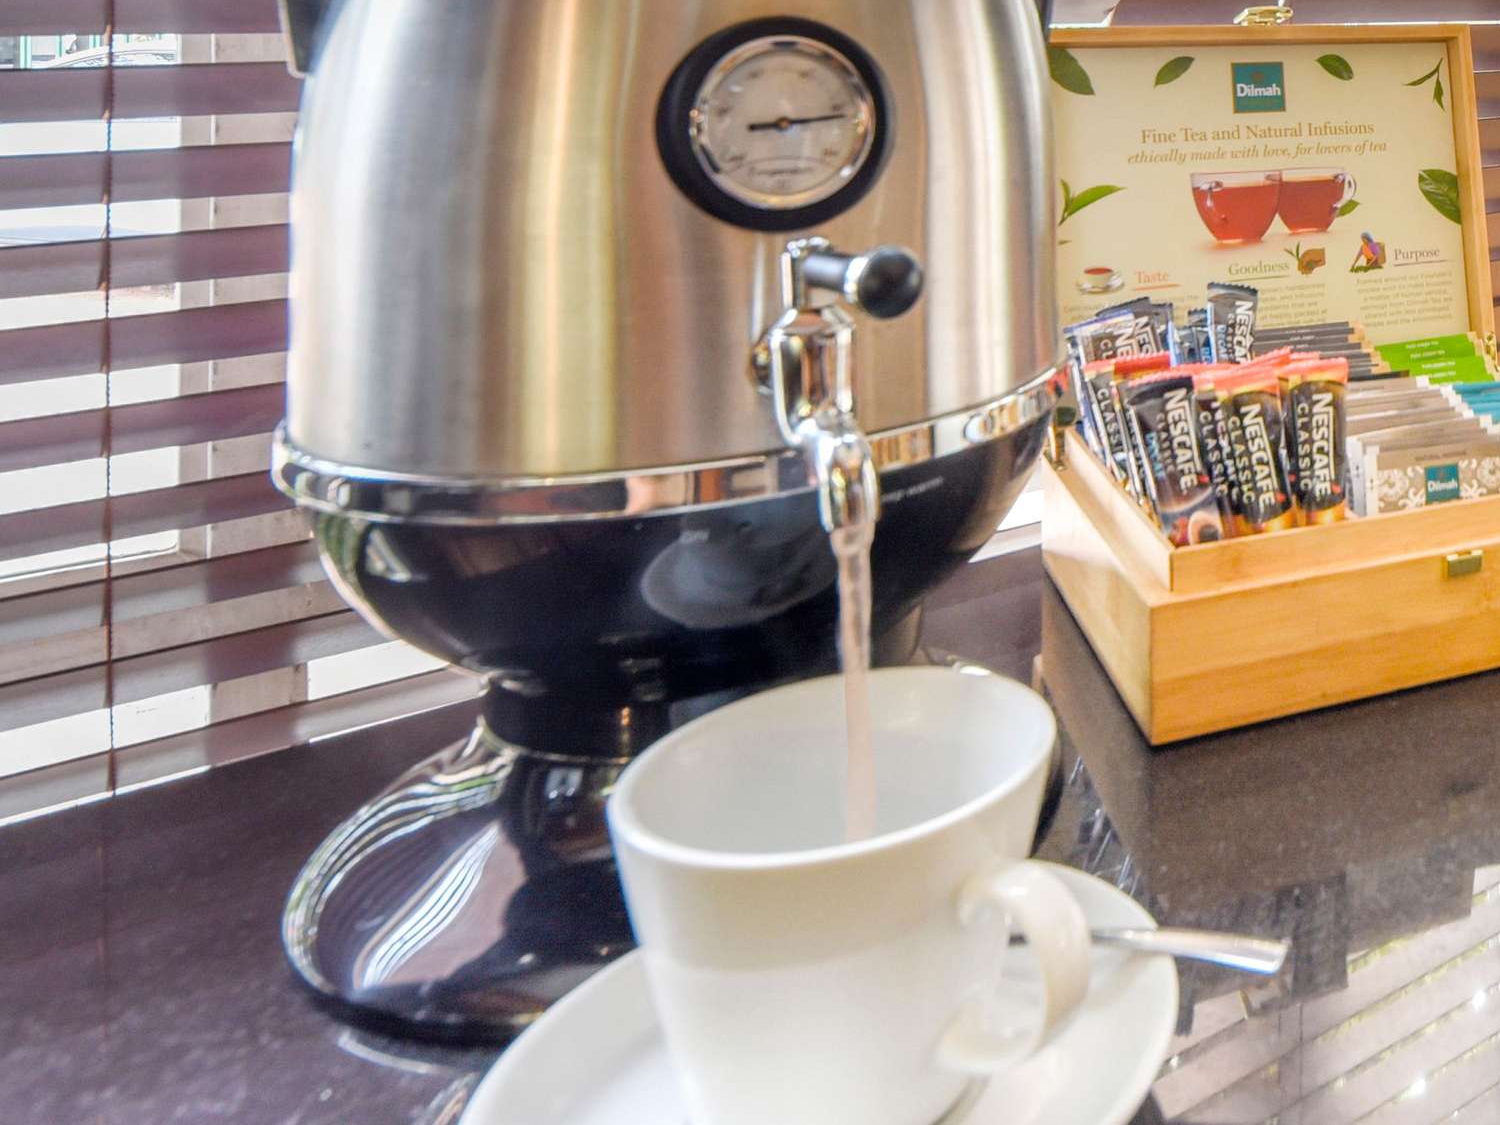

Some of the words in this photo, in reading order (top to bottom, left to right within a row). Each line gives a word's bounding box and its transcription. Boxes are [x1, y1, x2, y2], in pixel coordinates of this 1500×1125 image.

[1236, 83, 1281, 97] Dilmah
[1141, 129, 1176, 144] Fine
[1181, 127, 1208, 142] Tea
[1212, 125, 1240, 141] and
[1246, 123, 1302, 140] Natural
[1308, 121, 1375, 137] Infusions
[1127, 148, 1187, 165] ethically
[1191, 145, 1227, 161] made
[1230, 144, 1260, 160] with
[1263, 143, 1291, 159] love,
[1295, 141, 1315, 159] for
[1316, 141, 1351, 155] lovers
[1354, 139, 1371, 156] of
[1370, 141, 1387, 153] tea
[1394, 248, 1440, 262] Purpose
[1136, 270, 1169, 284] Taste
[1228, 259, 1290, 275] Goodness
[1097, 388, 1127, 454] CLASSI
[1199, 411, 1229, 497] CLASSIC
[1297, 403, 1312, 490] CLASSIC
[1228, 416, 1256, 504] CLASSIC
[1427, 479, 1458, 493] Dilmah
